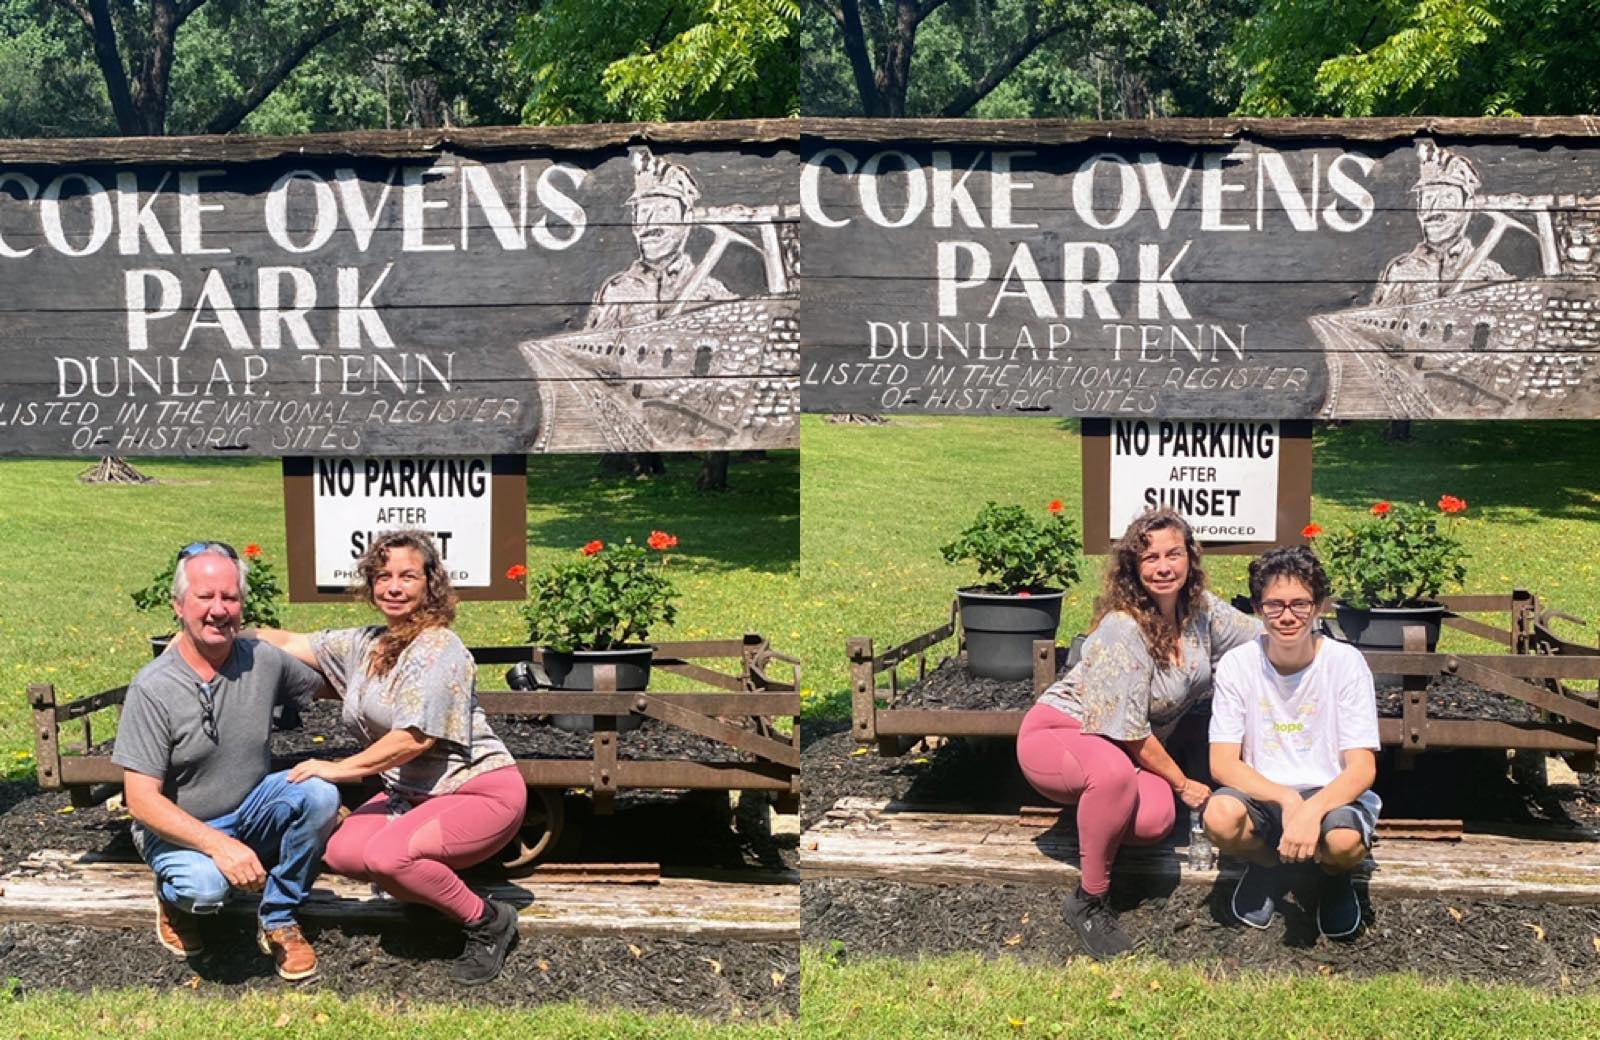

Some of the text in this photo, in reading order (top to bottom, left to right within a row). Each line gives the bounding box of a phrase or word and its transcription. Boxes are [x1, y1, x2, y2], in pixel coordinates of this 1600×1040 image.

[801, 147, 1377, 233] COKE OVENS
[265, 162, 588, 253] OVENS
[936, 240, 1193, 320] PARK
[124, 261, 396, 350] PARK
[804, 361, 1308, 391] LISTED IN THE NATIONAL REGISTER
[115, 401, 148, 425] IN
[156, 399, 215, 425] THE
[212, 399, 351, 425] NATIONAL
[366, 398, 520, 425] REGISTER
[881, 386, 1160, 414] OF HISTORIC SITES
[71, 424, 364, 450] OF HISTORIC SITES
[1116, 420, 1274, 459] NO PARKING
[319, 458, 486, 498] NO PARKING
[1169, 466, 1217, 483] AFTER
[376, 507, 427, 524] AFTER
[1143, 487, 1240, 517] SUNSET
[1191, 525, 1256, 535] NFORCED
